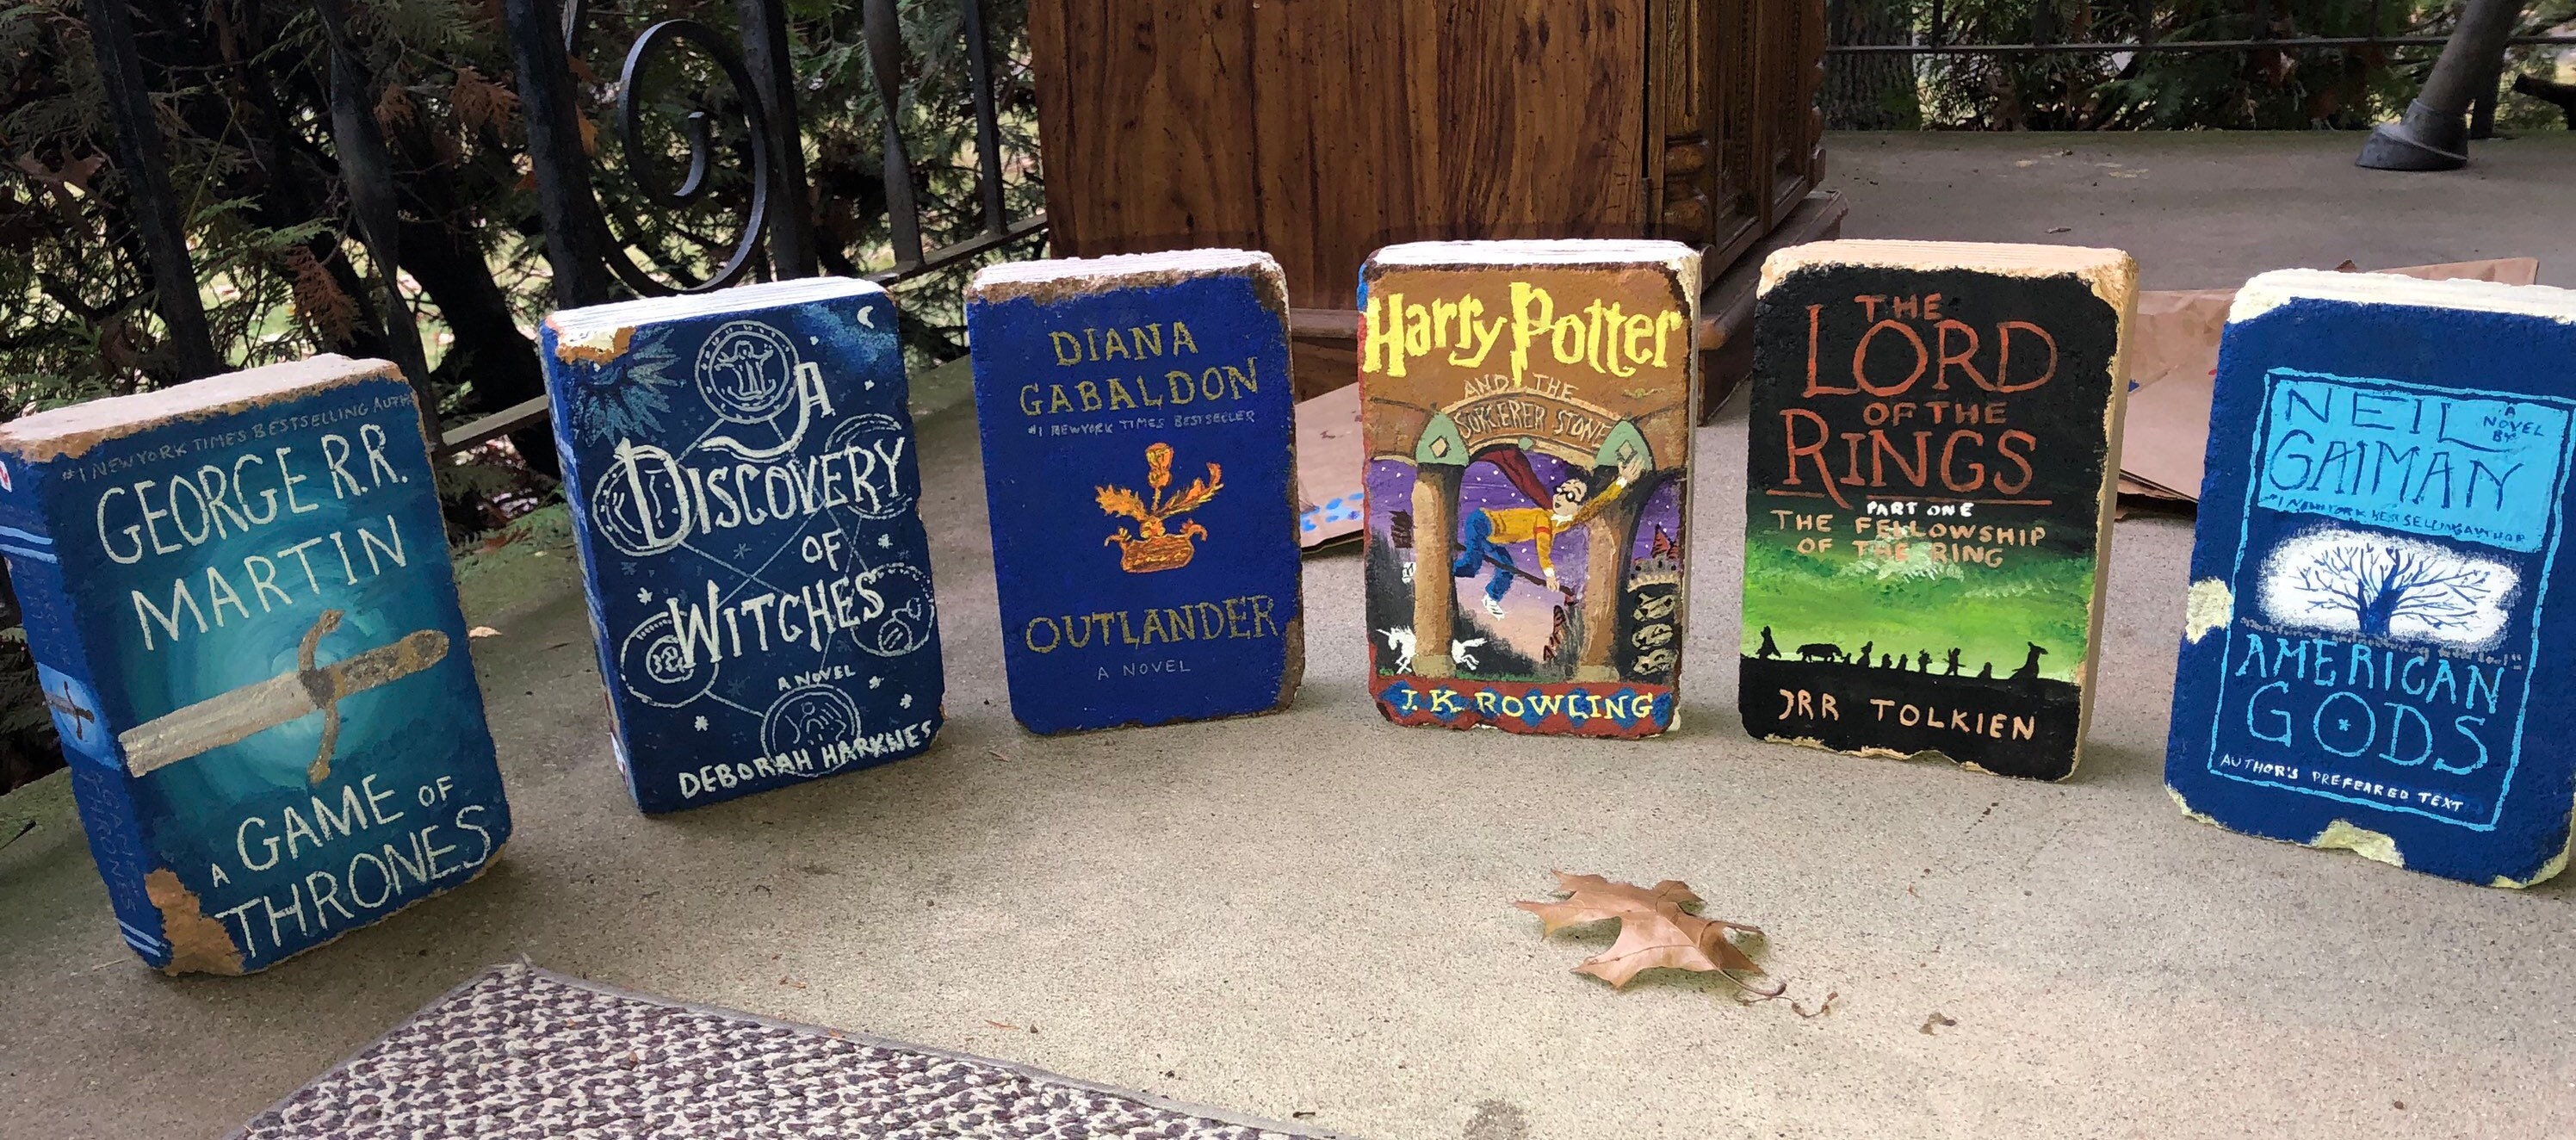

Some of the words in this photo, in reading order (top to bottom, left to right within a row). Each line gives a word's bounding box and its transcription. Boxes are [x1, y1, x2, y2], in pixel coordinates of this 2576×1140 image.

[1855, 293, 1942, 322] THE
[1049, 320, 1199, 367] DIANA
[1362, 293, 1508, 377] Harry
[1508, 281, 1684, 388] Potter
[1801, 303, 2058, 399] LORD
[1019, 356, 1260, 417] GABALDON
[1464, 374, 1509, 399] AND
[1533, 372, 1579, 401] THE
[2505, 406, 2516, 416] A
[192, 430, 247, 453] TIMES
[253, 402, 368, 440] BESTSELLING
[1118, 417, 1165, 430] TIMES
[1863, 402, 1917, 426] OF
[1925, 401, 2007, 424] THE
[2285, 387, 2512, 453] NEIL
[2483, 416, 2545, 437] NOVEL
[2492, 429, 2517, 443] BY
[1780, 408, 2037, 510] RINGS
[96, 446, 319, 565] GEORGE
[614, 437, 906, 548] DISCOVERY
[1867, 500, 1918, 517] PART
[1927, 502, 1975, 517] ONE
[802, 527, 843, 572] OF
[1769, 510, 1834, 532] THE
[1855, 517, 2047, 547] FELLOWSHIP
[1797, 537, 1833, 555] OF
[1852, 539, 1909, 561] THE
[1930, 542, 2004, 568] RING
[131, 514, 407, 652] MARTIN
[666, 572, 885, 668] WITCHES
[1025, 594, 1279, 654] OUTLANDER
[777, 675, 792, 691] A
[795, 665, 856, 687] NOVEL
[1097, 666, 1110, 680] A
[1123, 660, 1191, 677] NOVEL
[2235, 633, 2505, 714] AMERICAN
[1474, 691, 1654, 720] ROWLING
[1869, 698, 2035, 741] TOLKIEN
[2246, 681, 2488, 776] GODS
[678, 745, 814, 799] DEBORAH
[2220, 753, 2300, 781] AUTHOR'S
[2418, 791, 2464, 812] TEXT
[210, 861, 231, 888] A
[237, 773, 406, 872] GAME
[417, 775, 454, 808] OF
[214, 804, 491, 958] THRONES
